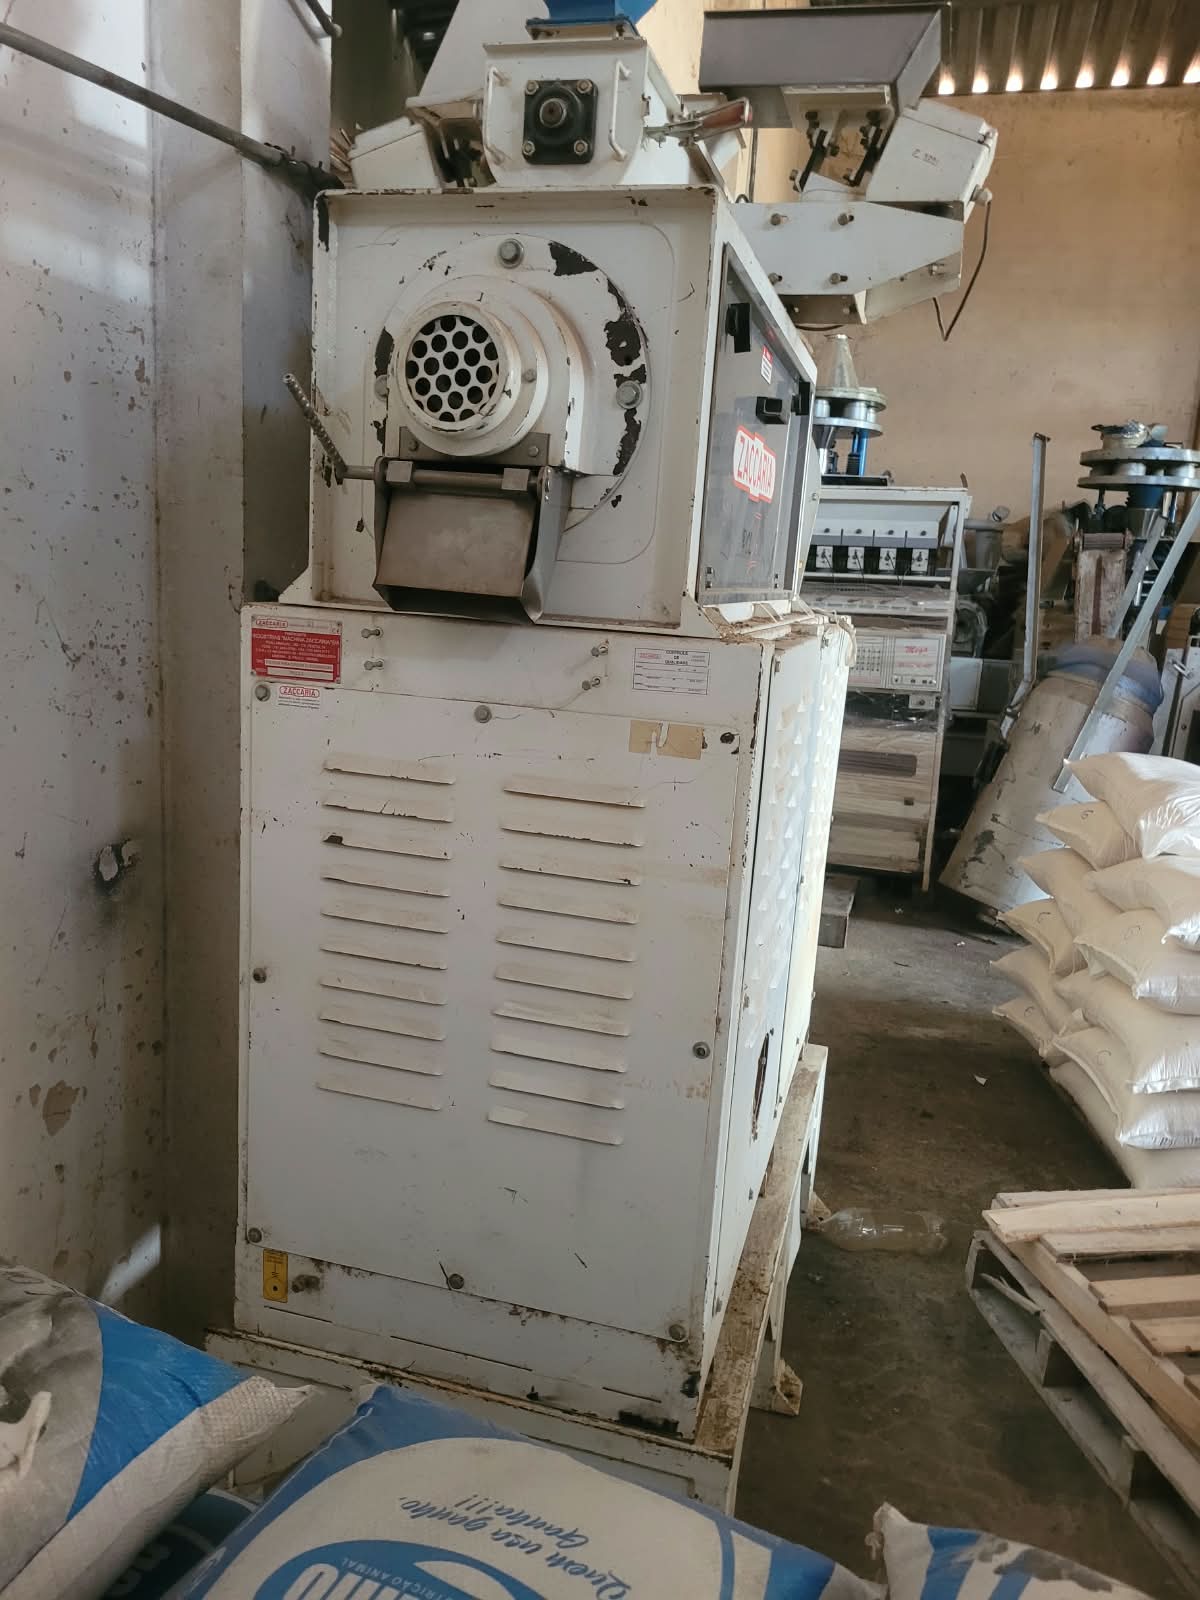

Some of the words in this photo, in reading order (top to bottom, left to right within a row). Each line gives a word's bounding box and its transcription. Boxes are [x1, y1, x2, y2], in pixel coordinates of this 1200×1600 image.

[737, 435, 775, 496] ZACCARIA
[283, 687, 316, 697] ZACCARIA
[454, 1493, 590, 1549] Ganha!!!
[491, 1527, 543, 1555] usa
[341, 1556, 392, 1581] ANIMAL
[545, 1551, 632, 1600] Quem
